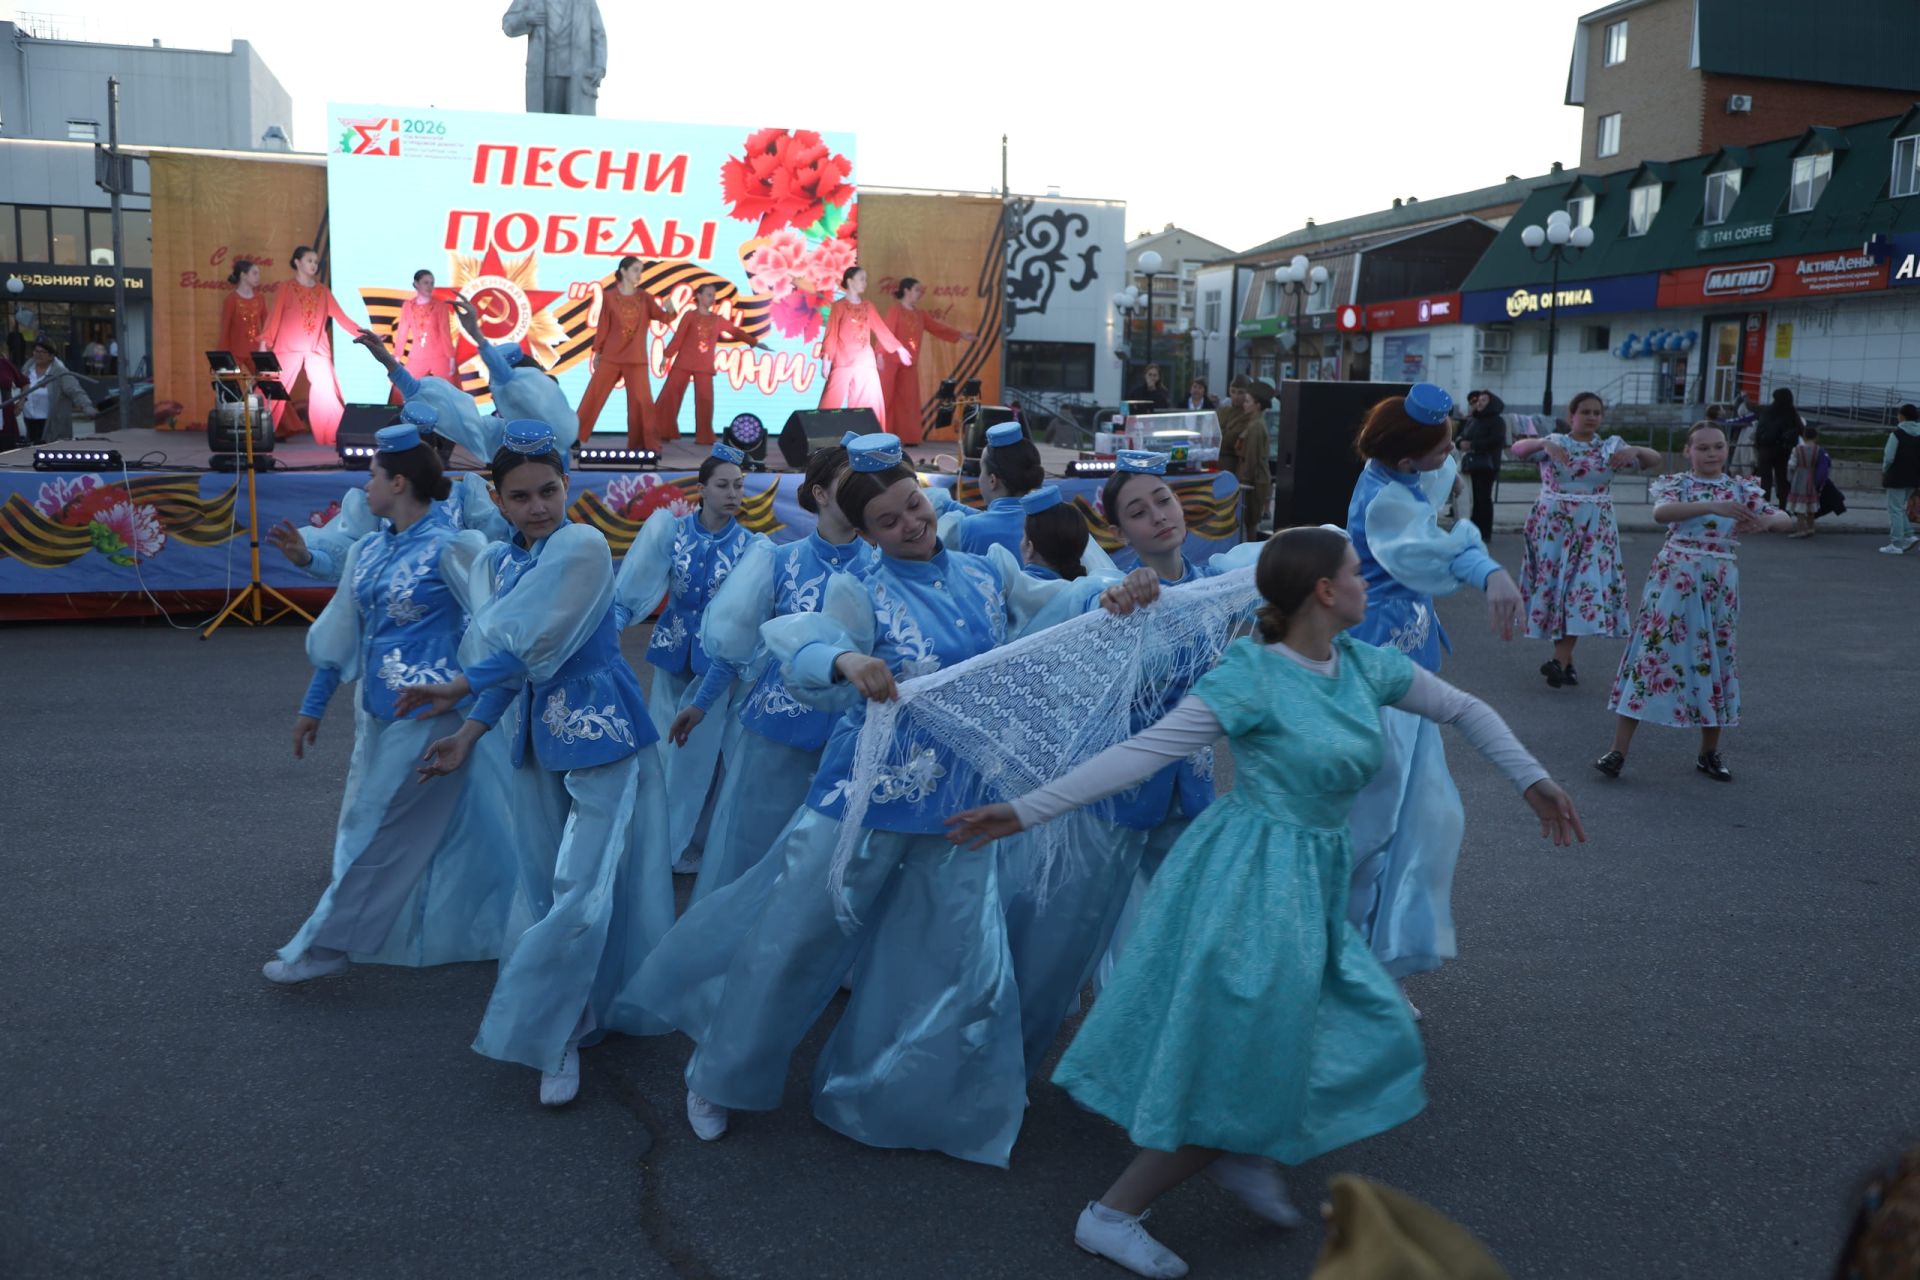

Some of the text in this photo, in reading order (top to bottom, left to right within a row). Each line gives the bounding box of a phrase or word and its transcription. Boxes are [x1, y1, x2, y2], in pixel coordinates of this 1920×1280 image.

[403, 119, 446, 135] 2026
[472, 143, 689, 194] ПЕСНИ
[444, 210, 717, 260] ПОБЕДЫ
[1713, 224, 1773, 243] 1741 COFFEE
[1708, 269, 1768, 289] МАГНИТ
